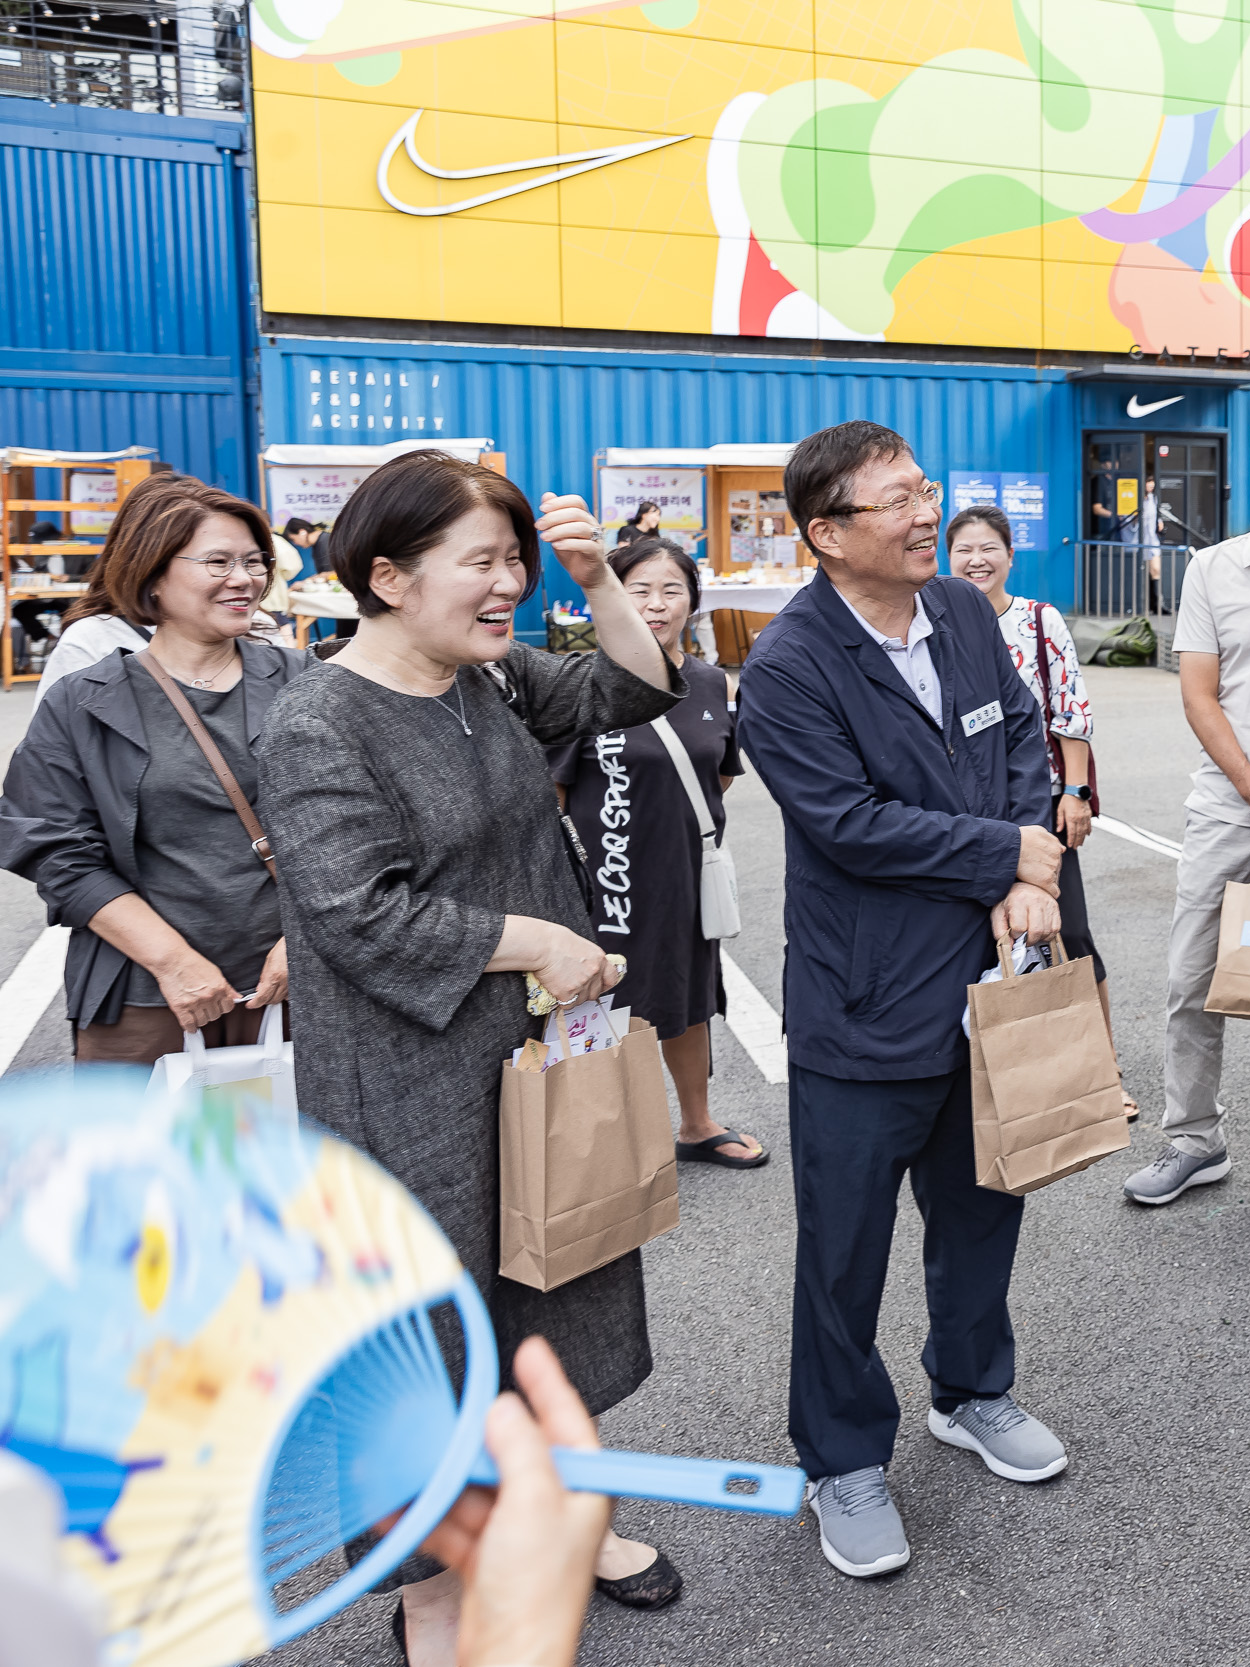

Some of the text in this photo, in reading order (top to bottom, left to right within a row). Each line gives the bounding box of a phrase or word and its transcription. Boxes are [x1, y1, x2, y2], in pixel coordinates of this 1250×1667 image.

[309, 369, 410, 388] RETAIL
[310, 391, 361, 407] F&B
[311, 413, 444, 431] ACTIVITY
[595, 729, 632, 935] LE COQ SPORTI
